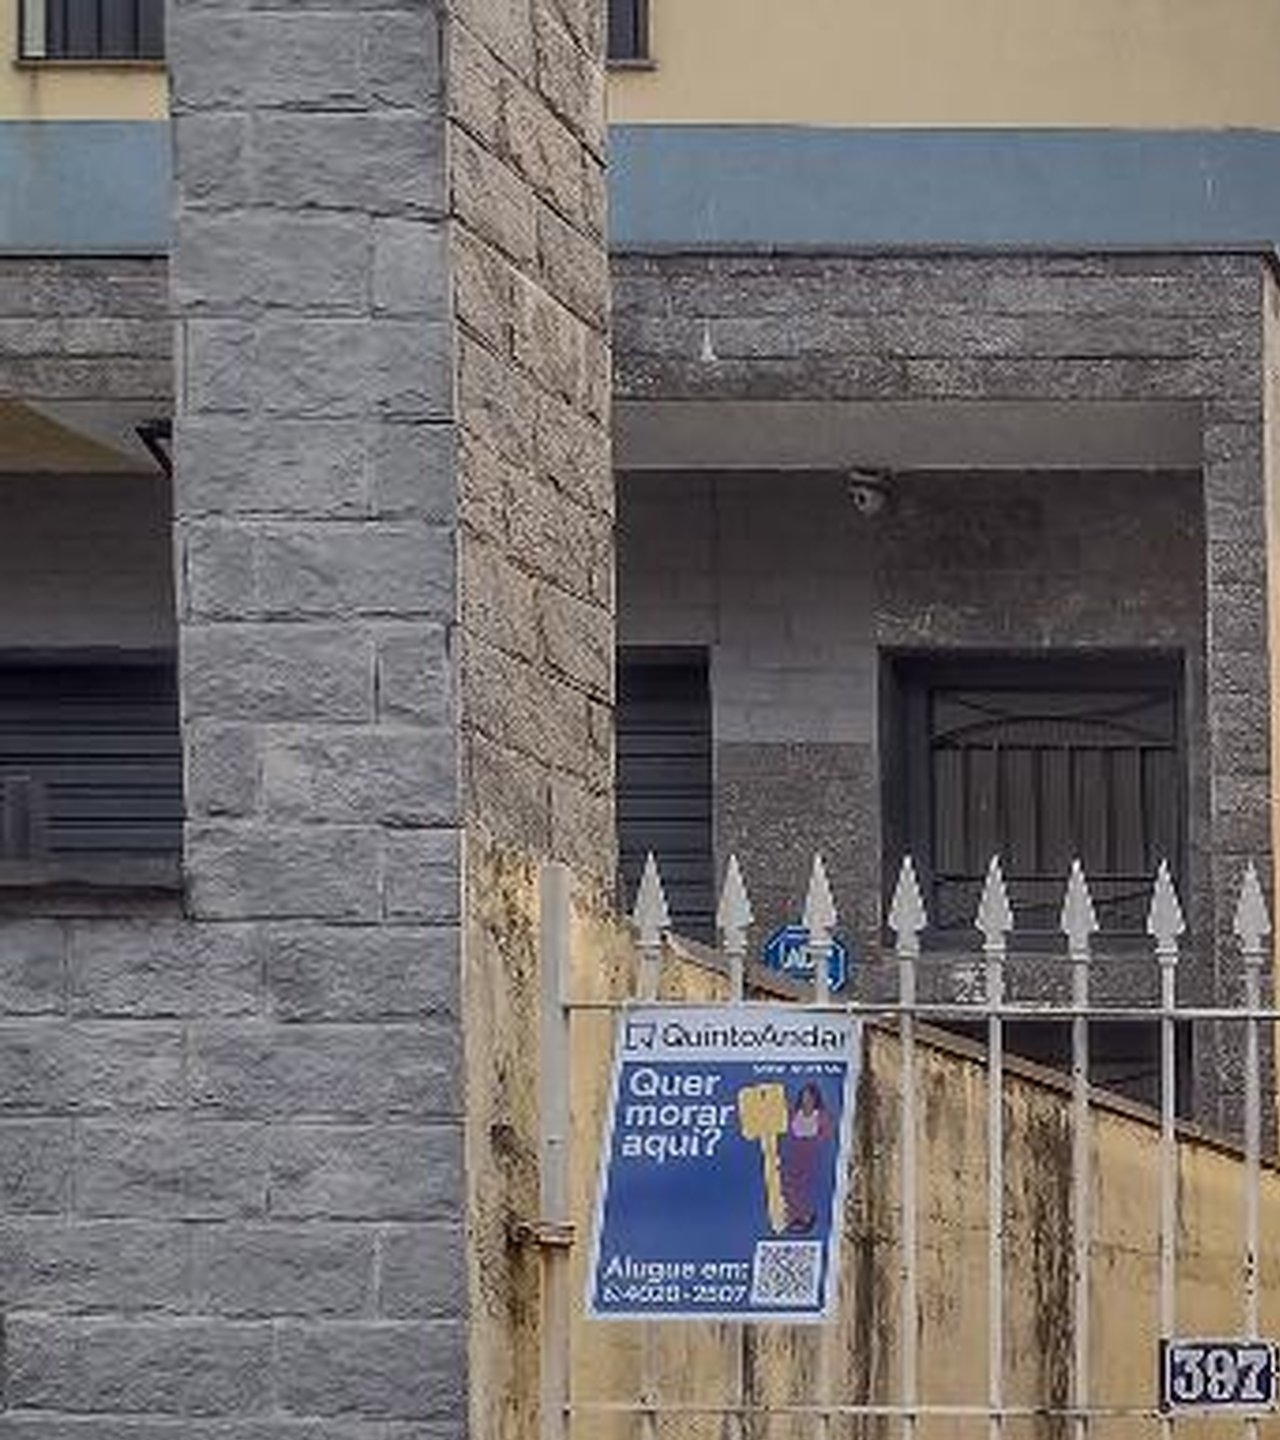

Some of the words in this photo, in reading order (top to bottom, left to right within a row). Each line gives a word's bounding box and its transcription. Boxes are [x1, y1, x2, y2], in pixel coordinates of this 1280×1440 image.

[662, 1022, 846, 1049] QuintoAndar
[629, 1068, 721, 1097] Quer
[624, 1104, 735, 1126] morar
[621, 1127, 723, 1162] aqui?
[602, 1255, 694, 1283] Alugue
[1173, 1349, 1268, 1400] 397
